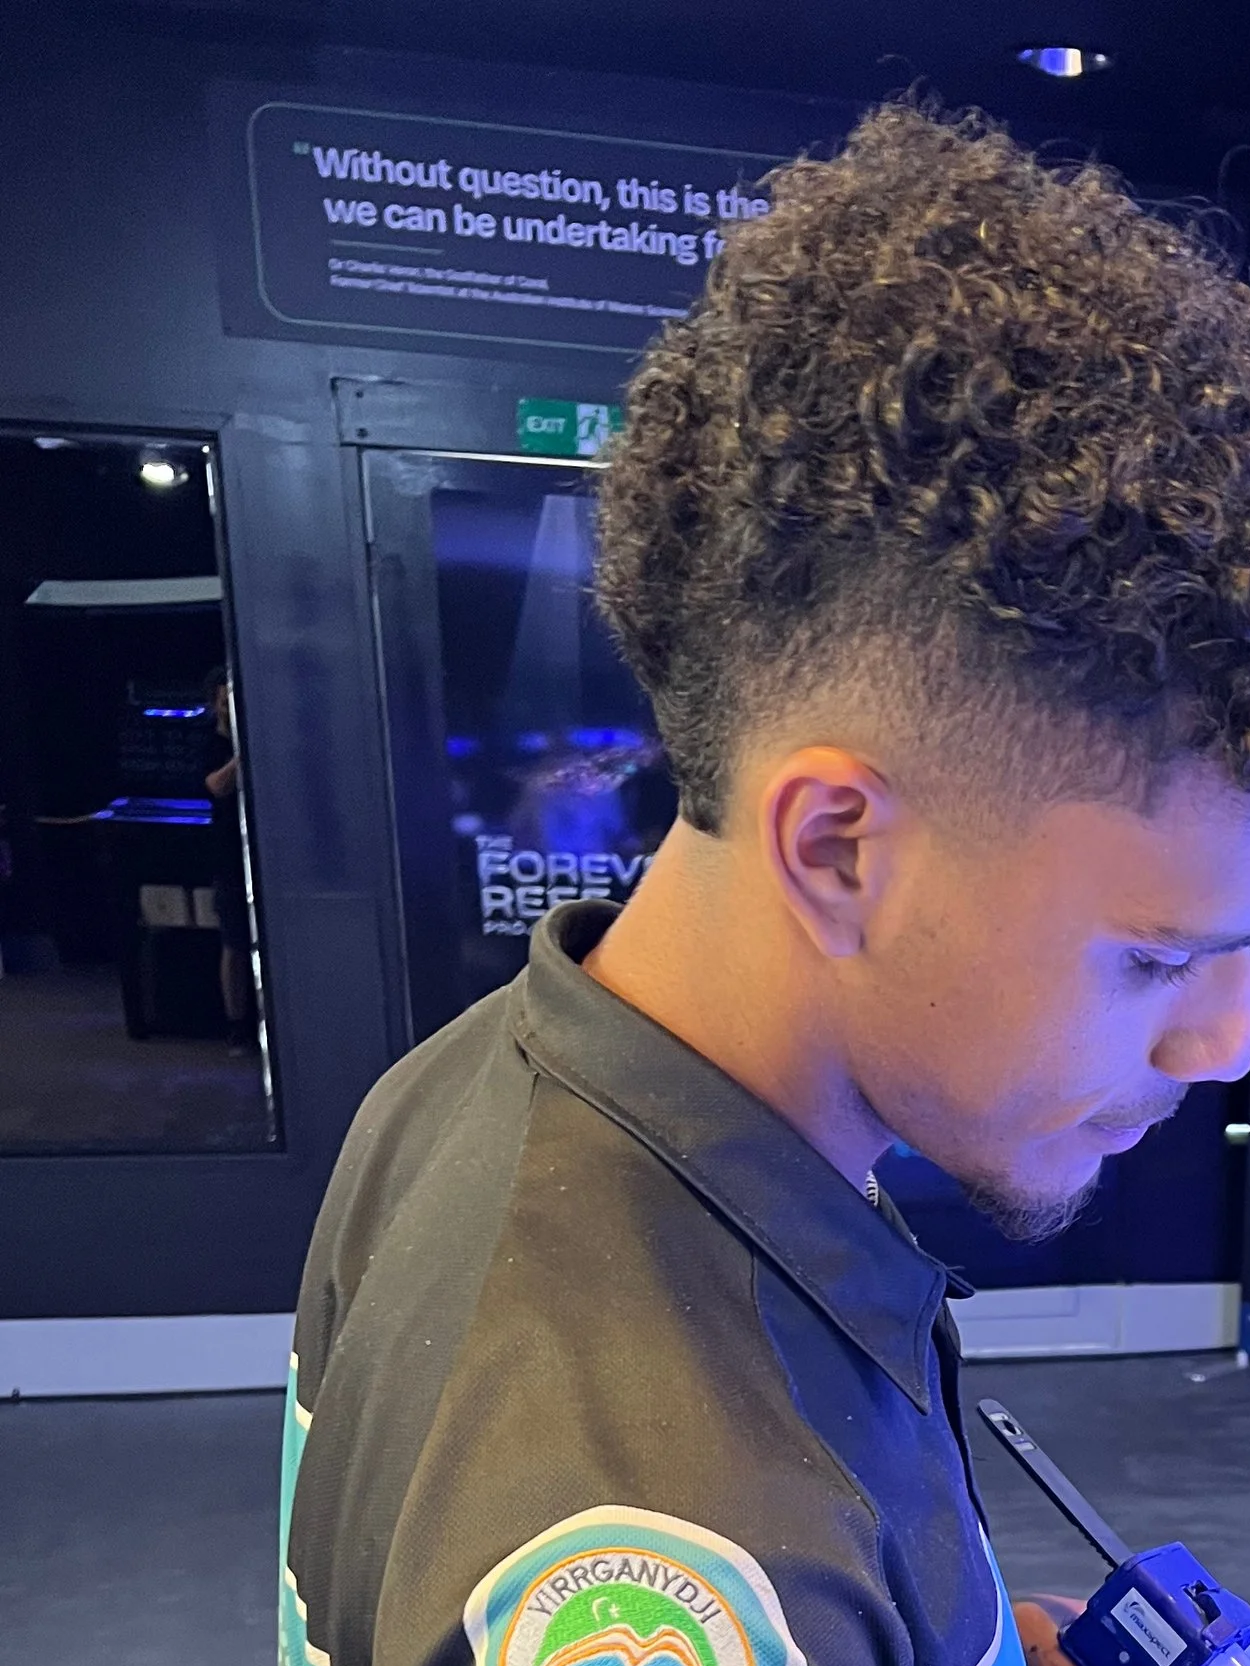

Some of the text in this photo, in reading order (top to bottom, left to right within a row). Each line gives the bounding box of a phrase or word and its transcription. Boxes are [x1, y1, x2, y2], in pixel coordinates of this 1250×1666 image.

[313, 146, 769, 219] Without question, this is the
[323, 198, 377, 226] we
[384, 203, 447, 232] can
[454, 203, 497, 238] be
[503, 214, 698, 265] undertaking
[526, 416, 566, 433] EXIT
[476, 835, 513, 850] THE
[477, 850, 655, 886] FOREV
[527, 1558, 722, 1624] YIRRGANYDJI
[1129, 1613, 1171, 1660] maxspect
